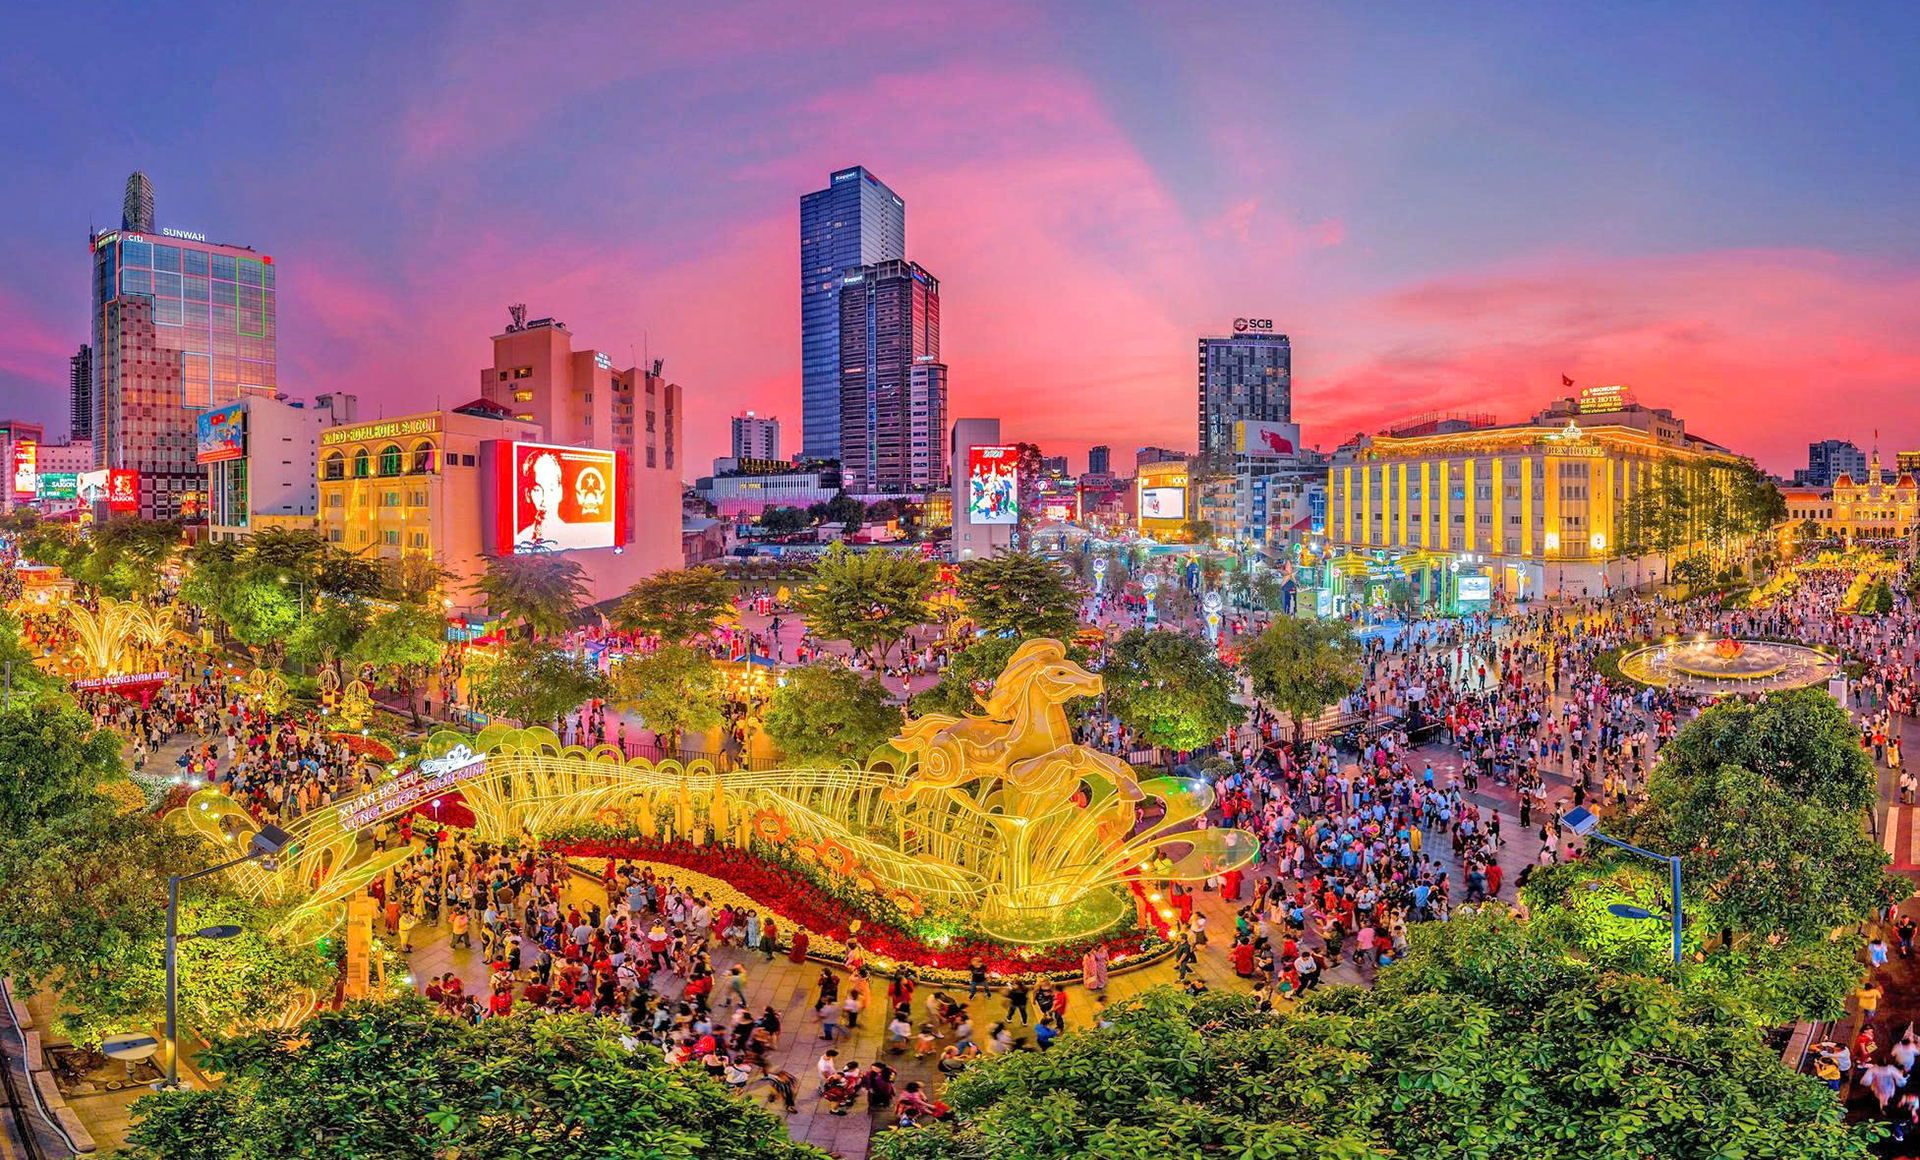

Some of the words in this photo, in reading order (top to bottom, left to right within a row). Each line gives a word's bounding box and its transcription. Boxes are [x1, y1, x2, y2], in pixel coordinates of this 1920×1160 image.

[128, 233, 144, 243] citi
[163, 227, 205, 241] SUNWAH
[1249, 318, 1273, 328] SCB
[1598, 395, 1622, 403] HOTEL
[1548, 446, 1567, 455] REX
[1569, 446, 1605, 457] HOTEL
[1172, 476, 1188, 485] KKV
